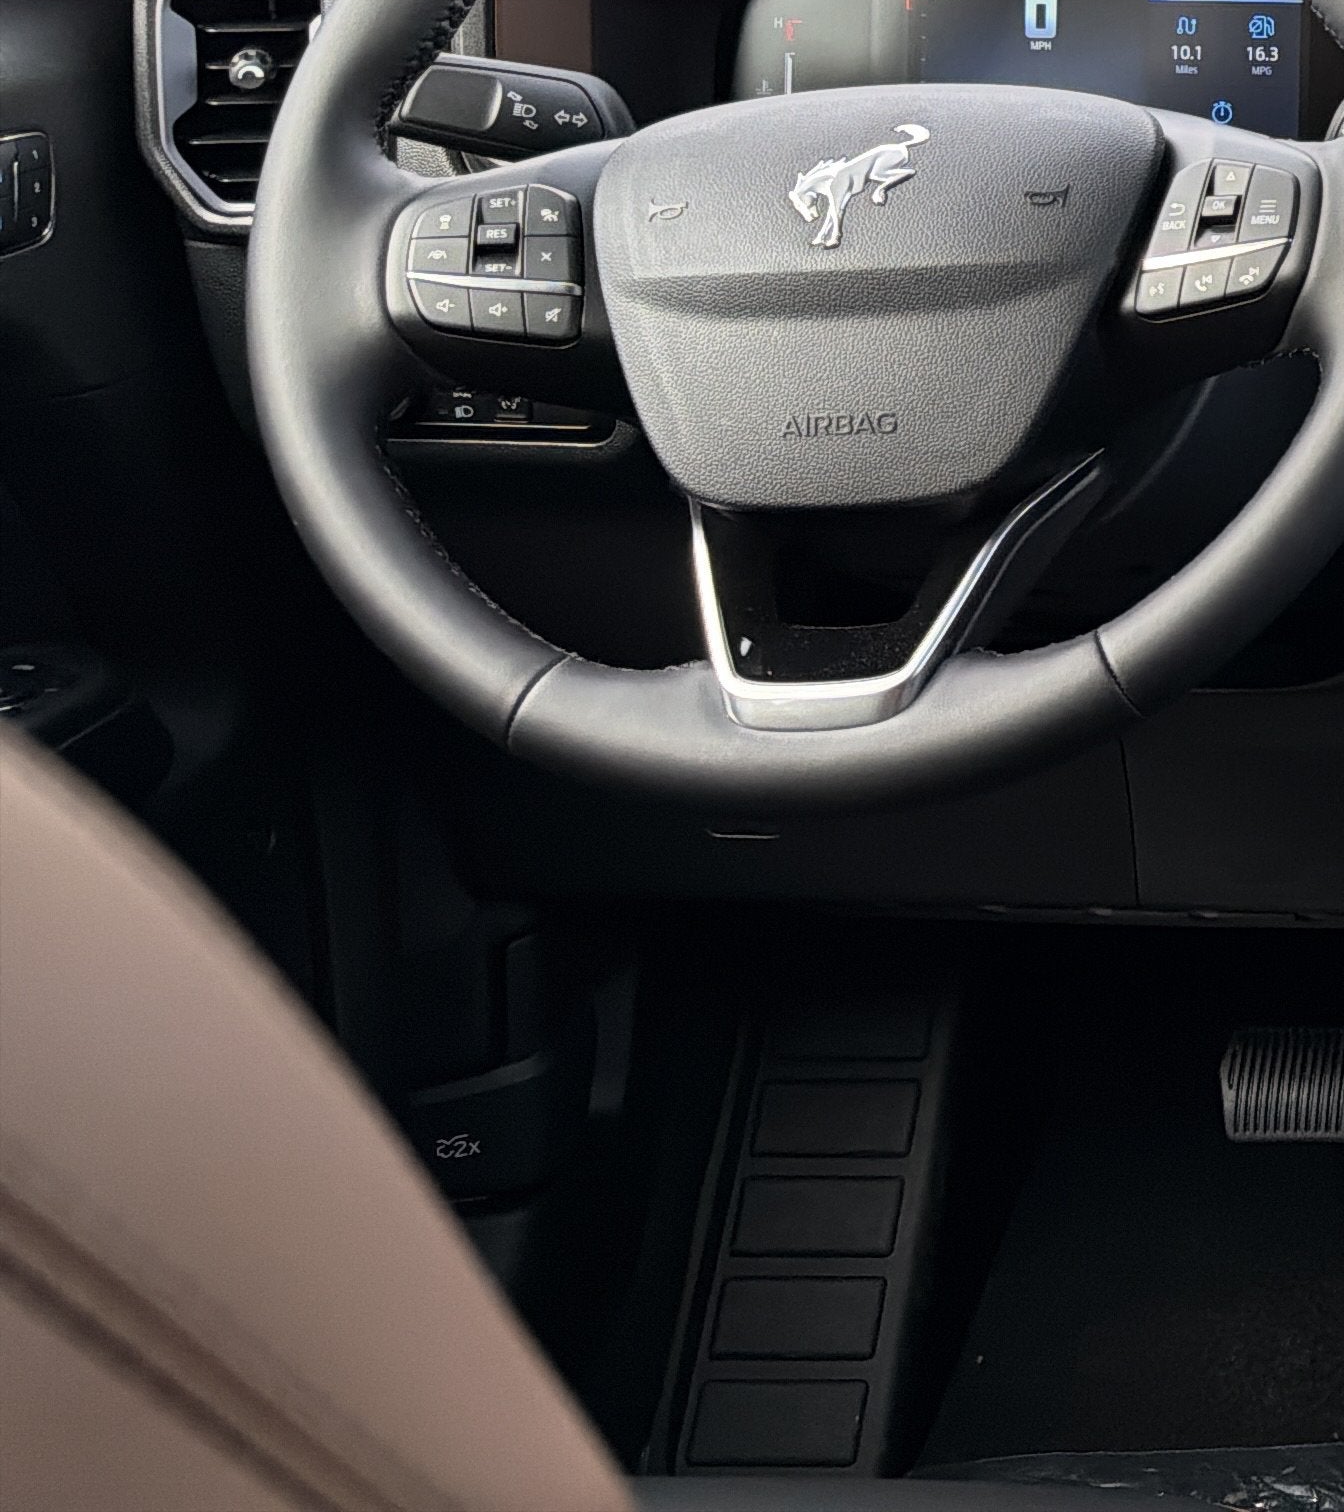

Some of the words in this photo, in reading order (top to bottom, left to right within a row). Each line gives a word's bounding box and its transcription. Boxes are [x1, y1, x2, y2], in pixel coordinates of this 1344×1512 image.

[773, 16, 784, 29] H
[1030, 40, 1052, 51] MPH
[1171, 44, 1203, 61] 10.1
[1246, 45, 1280, 62] 16.3
[1175, 64, 1199, 75] Miles
[1251, 65, 1273, 76] MPG
[1211, 199, 1228, 212] OK
[1162, 218, 1187, 232] BACK
[1249, 213, 1281, 227] MENU
[486, 229, 508, 239] RES
[780, 410, 899, 440] AIRBAG
